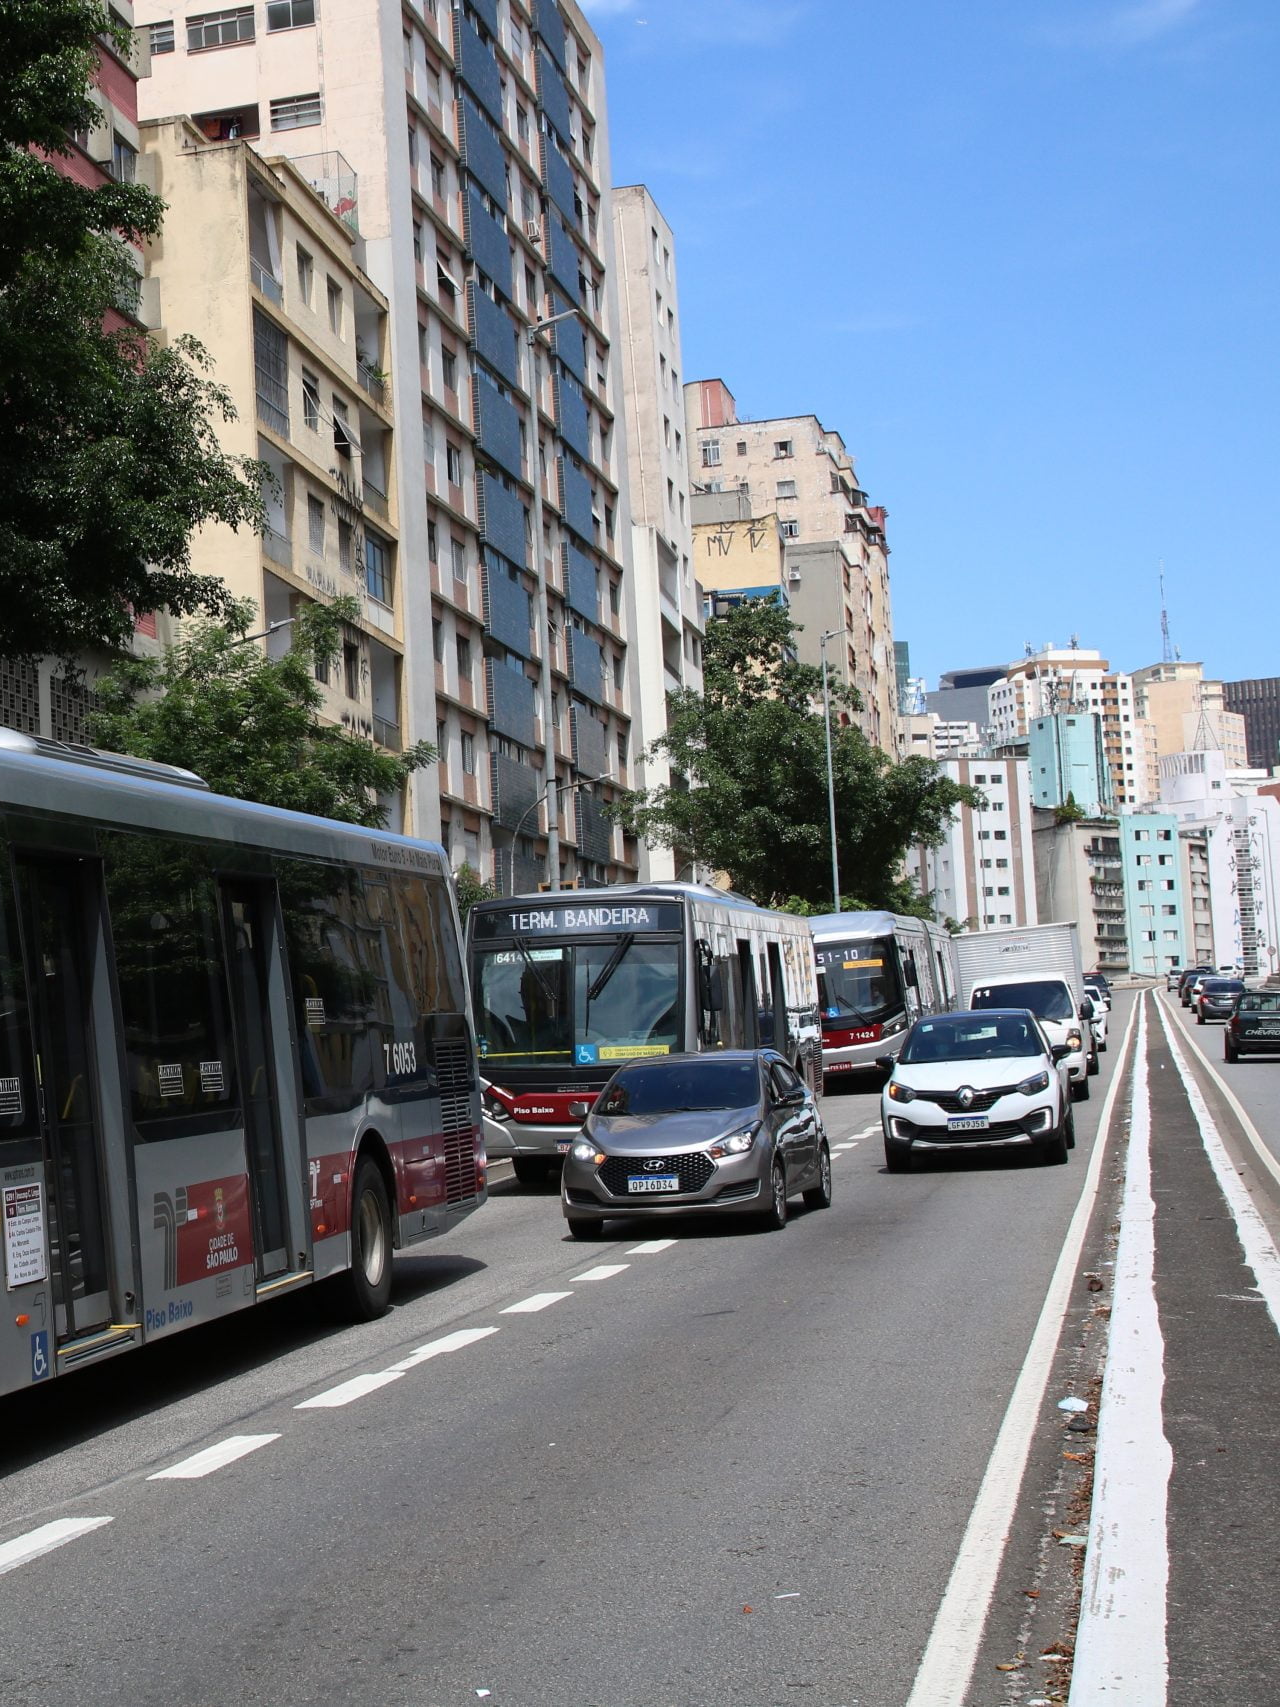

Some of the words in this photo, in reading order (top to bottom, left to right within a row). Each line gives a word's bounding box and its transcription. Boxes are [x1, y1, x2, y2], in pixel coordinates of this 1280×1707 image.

[509, 911, 557, 930] TERM.
[564, 908, 649, 928] BANDEIRA
[856, 1031, 874, 1039] 1424
[393, 1041, 417, 1075] 6053
[531, 1106, 555, 1114] Baixo
[209, 1235, 227, 1250] CIDADE
[227, 1232, 235, 1245] DE
[206, 1249, 219, 1269] SÃO
[219, 1246, 238, 1265] PAULO
[145, 1308, 166, 1331] Piso
[168, 1300, 193, 1323] Baixo
